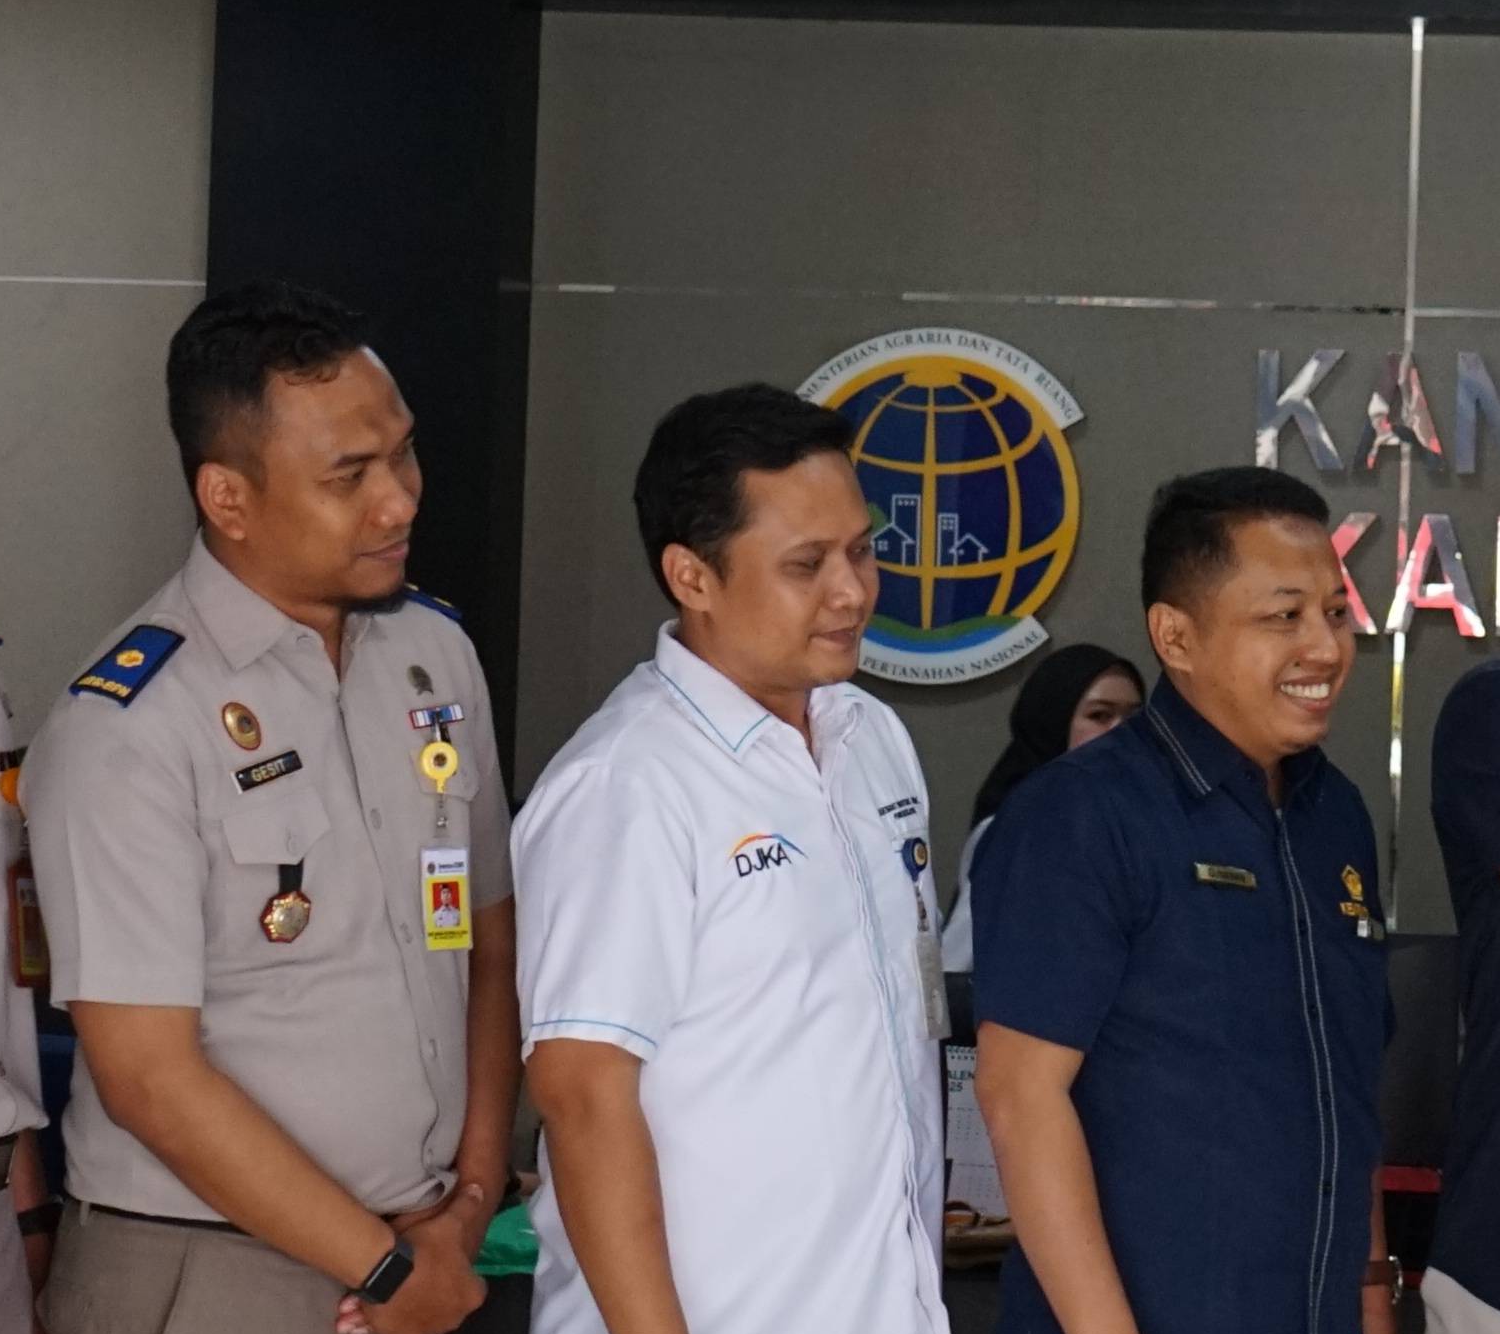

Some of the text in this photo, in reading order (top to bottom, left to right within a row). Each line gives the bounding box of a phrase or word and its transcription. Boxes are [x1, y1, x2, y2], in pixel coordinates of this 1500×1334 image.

[883, 332, 953, 351] AGRARIA
[957, 334, 990, 353] DAN
[994, 345, 1031, 374] TATA
[1033, 372, 1076, 422] RUANG
[861, 630, 1041, 680] PERTANAHAN NASIONAL
[251, 760, 287, 782] GESIT
[734, 843, 794, 878] DJKA
